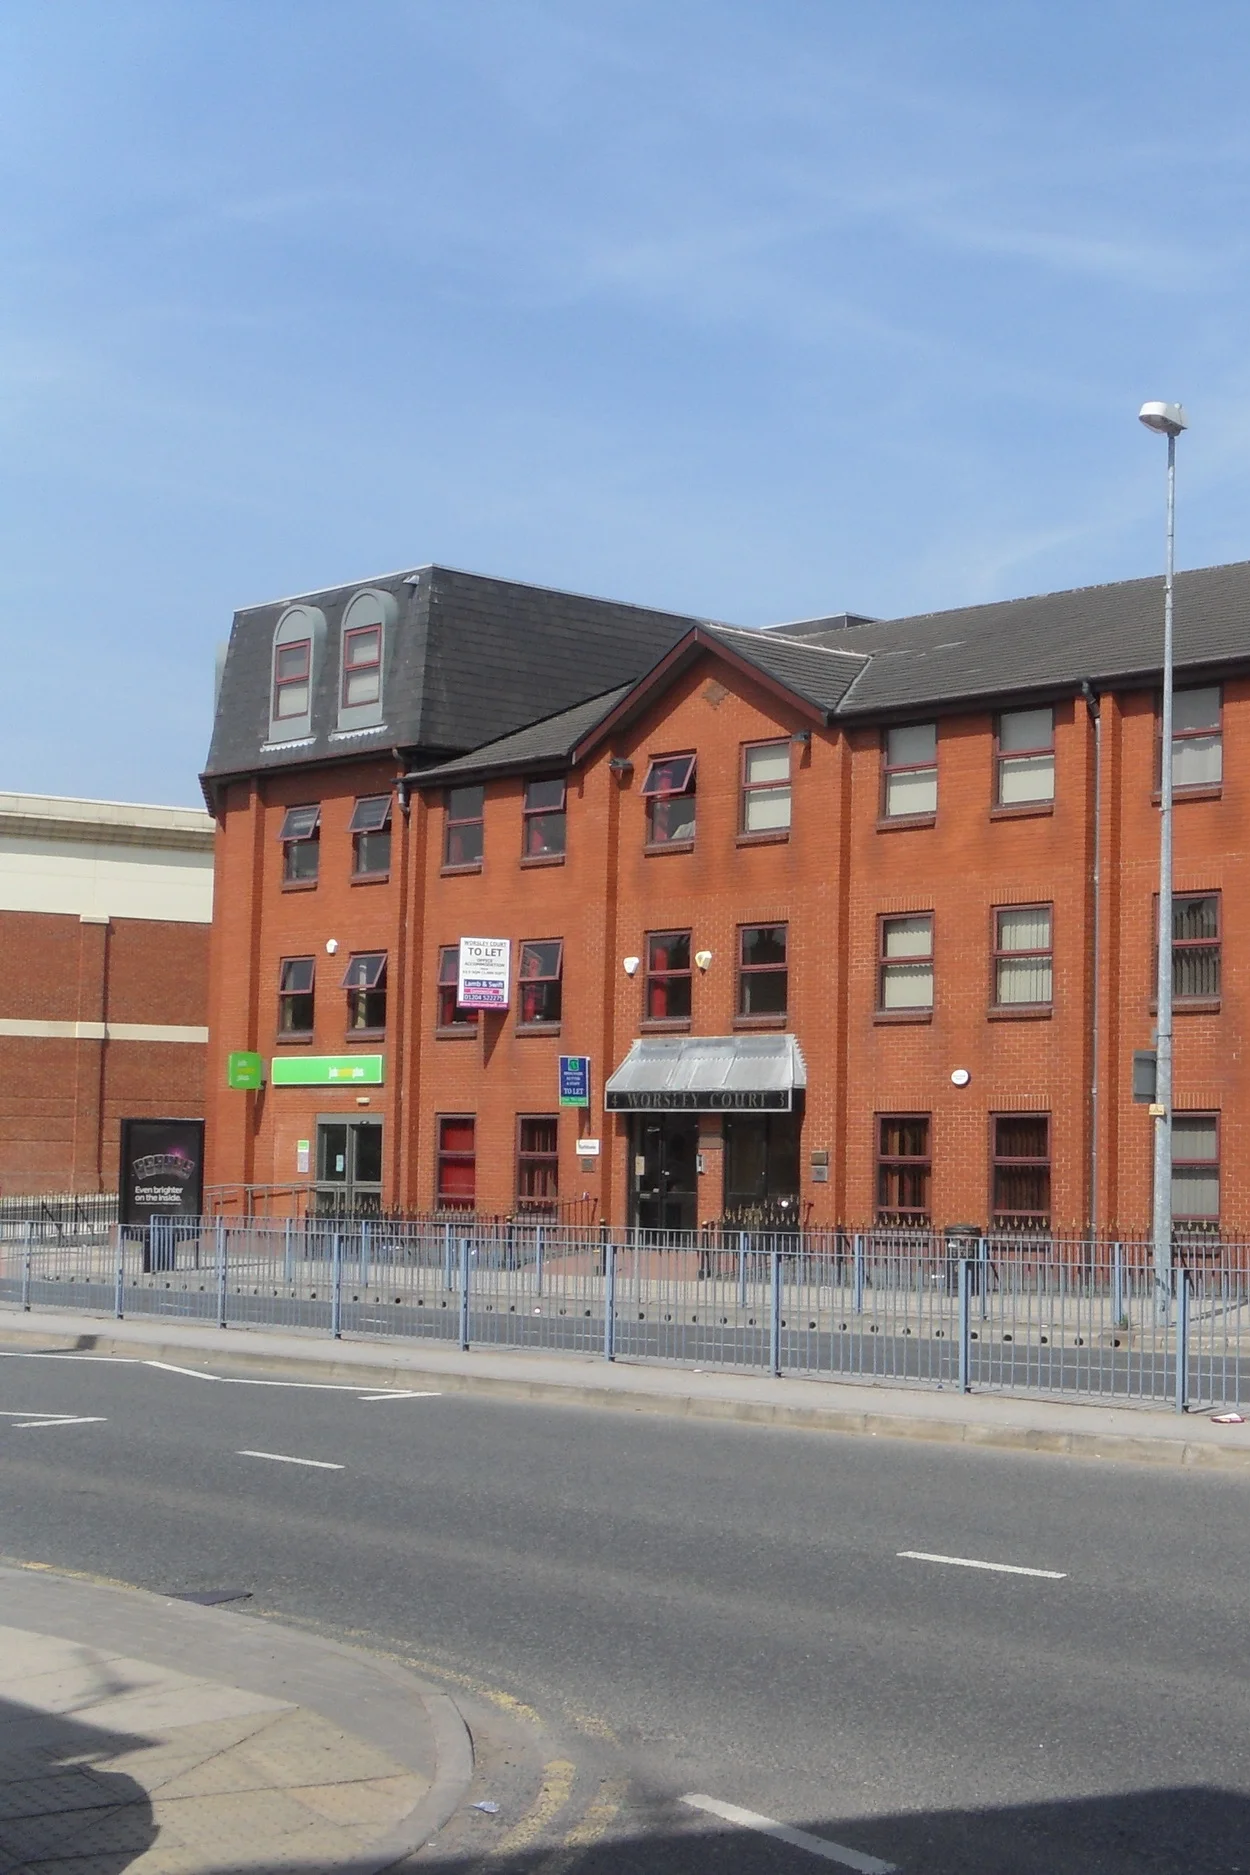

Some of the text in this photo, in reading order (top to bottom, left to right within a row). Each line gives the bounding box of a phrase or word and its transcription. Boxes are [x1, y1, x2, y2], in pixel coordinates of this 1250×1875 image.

[468, 947, 503, 957] TO LET
[611, 1091, 785, 1108] 4 WORSLEY COURT 3
[135, 1185, 184, 1196] Even brighter
[134, 1194, 182, 1202] on the inside.
